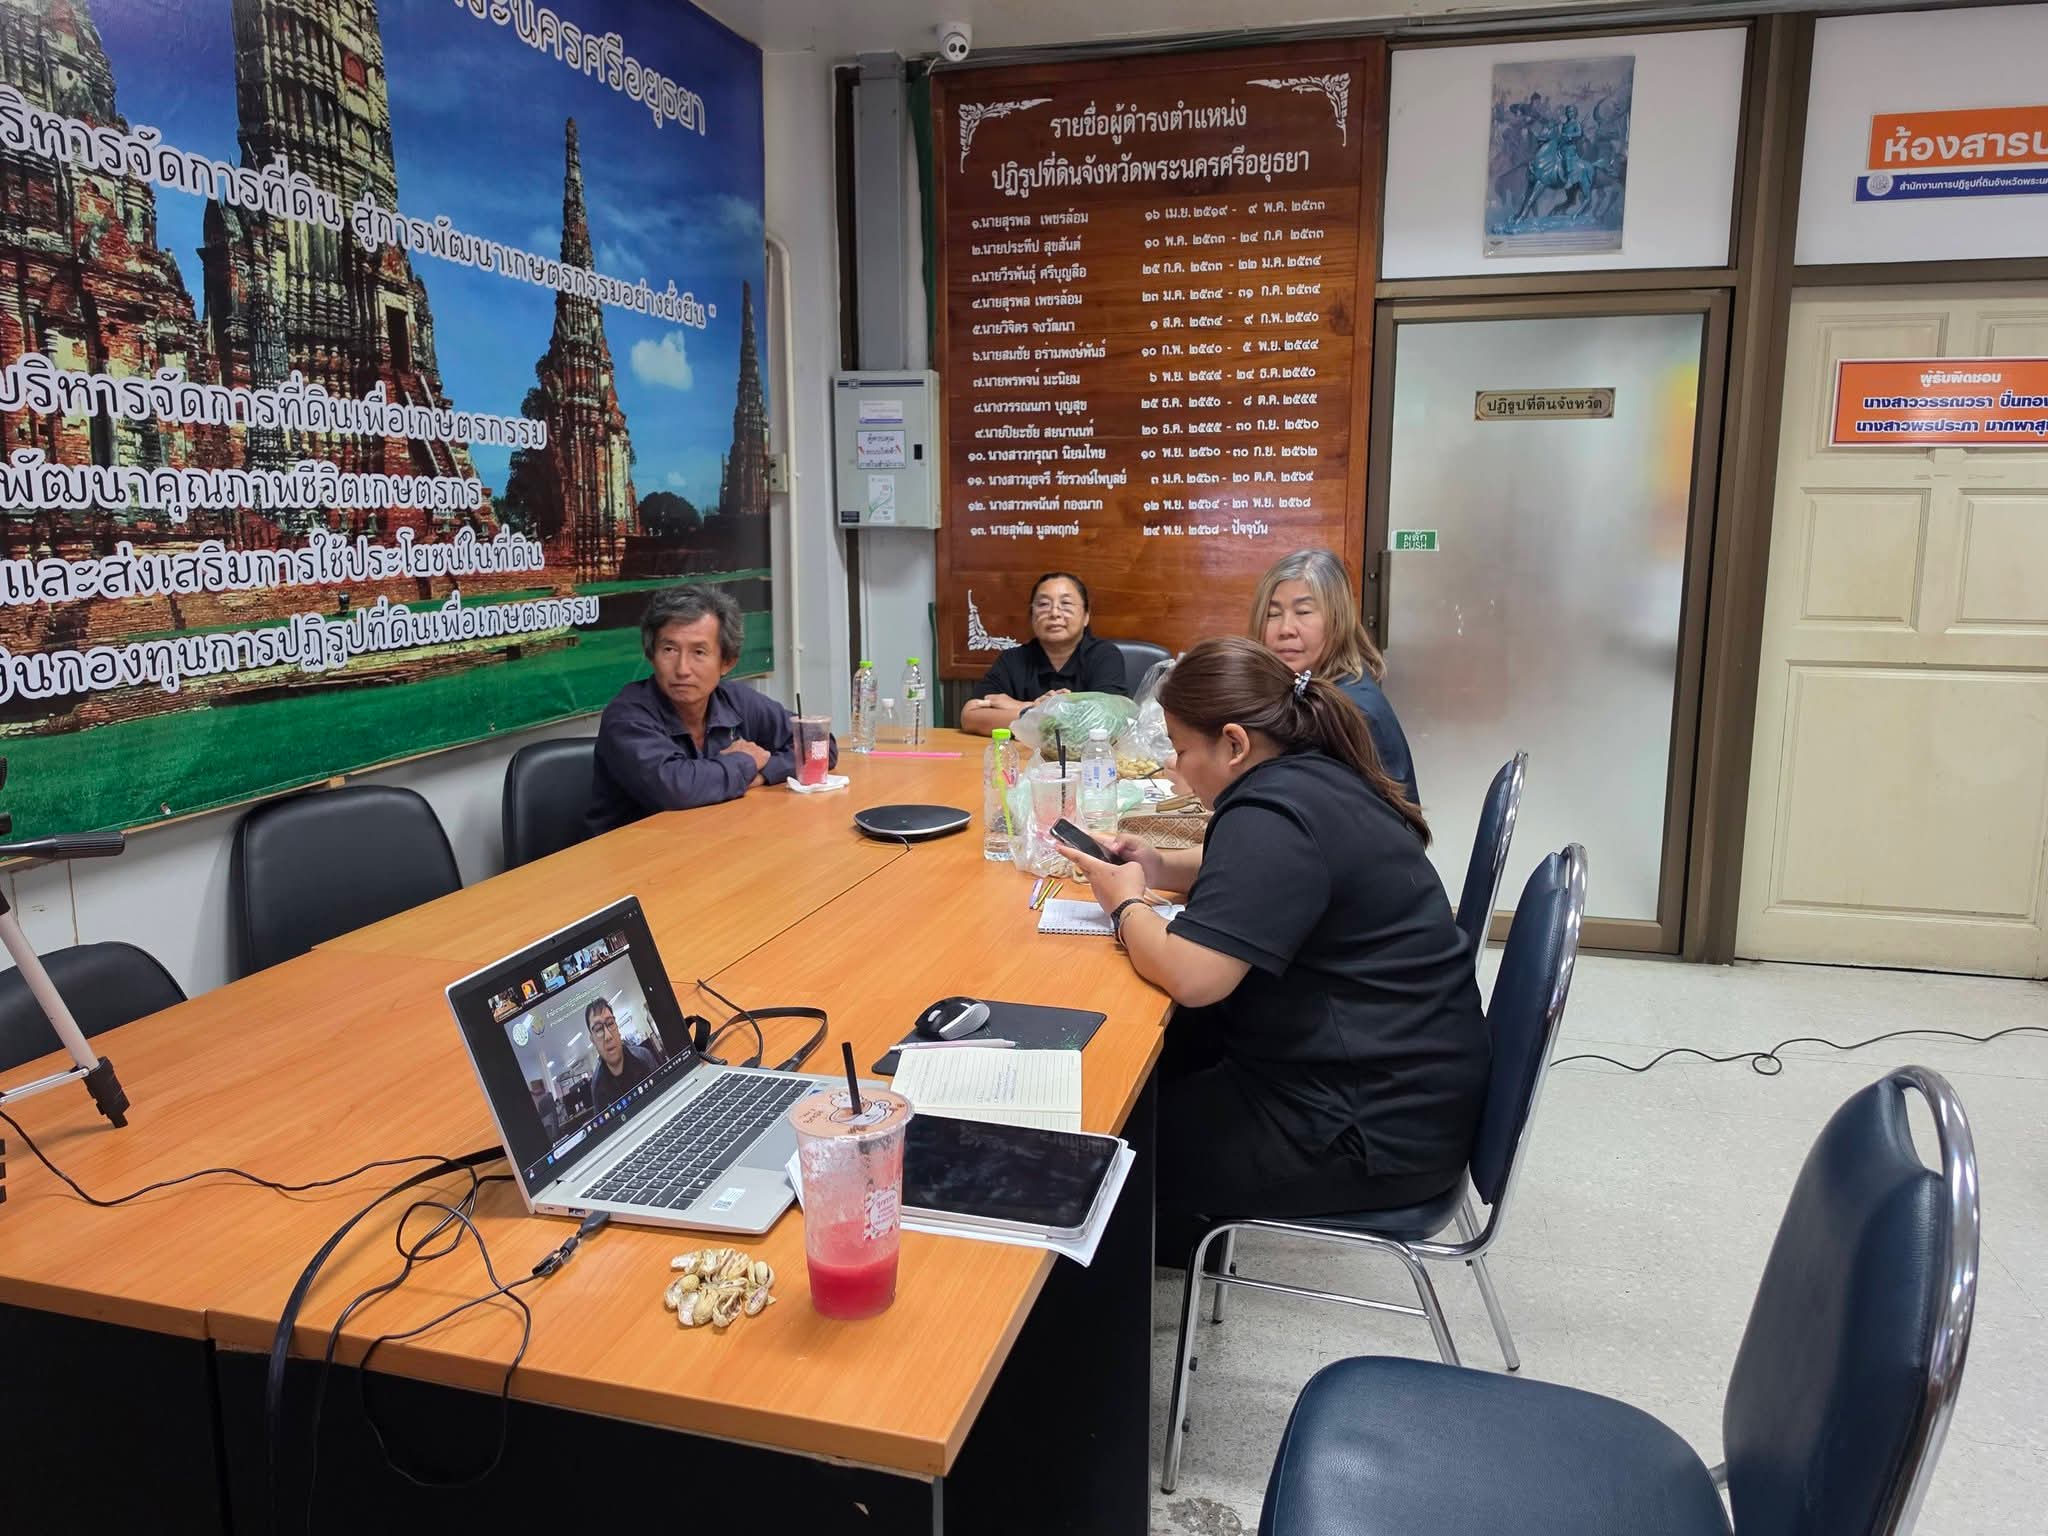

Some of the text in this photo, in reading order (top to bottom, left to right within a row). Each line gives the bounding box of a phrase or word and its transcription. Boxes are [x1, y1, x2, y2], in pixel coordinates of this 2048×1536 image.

[1050, 99, 1247, 144] รายชื่อผู้ดำรงตำแหน่ง
[992, 146, 1310, 198] ปฏิรูปที่ดินจังหวัดพระนครศรีอยุธยา
[1040, 208, 1089, 225] เพชรล้อม
[1920, 370, 2001, 387] ผู้รับผิดชอบ
[1487, 394, 1603, 415] ปฏิรูปที่ดินจังหวัด
[1863, 397, 1993, 409] นางสาววรรณวรา
[1856, 419, 2048, 435] นางสาวพรประภา มากผาสุ
[0, 453, 481, 523] พัฒนาคุณภาพชีวิตเกษตรกร
[1403, 541, 1427, 550] PUSH
[9, 526, 542, 600] และส่งเสริมการใช้ประโยชน์ในที่ดิน
